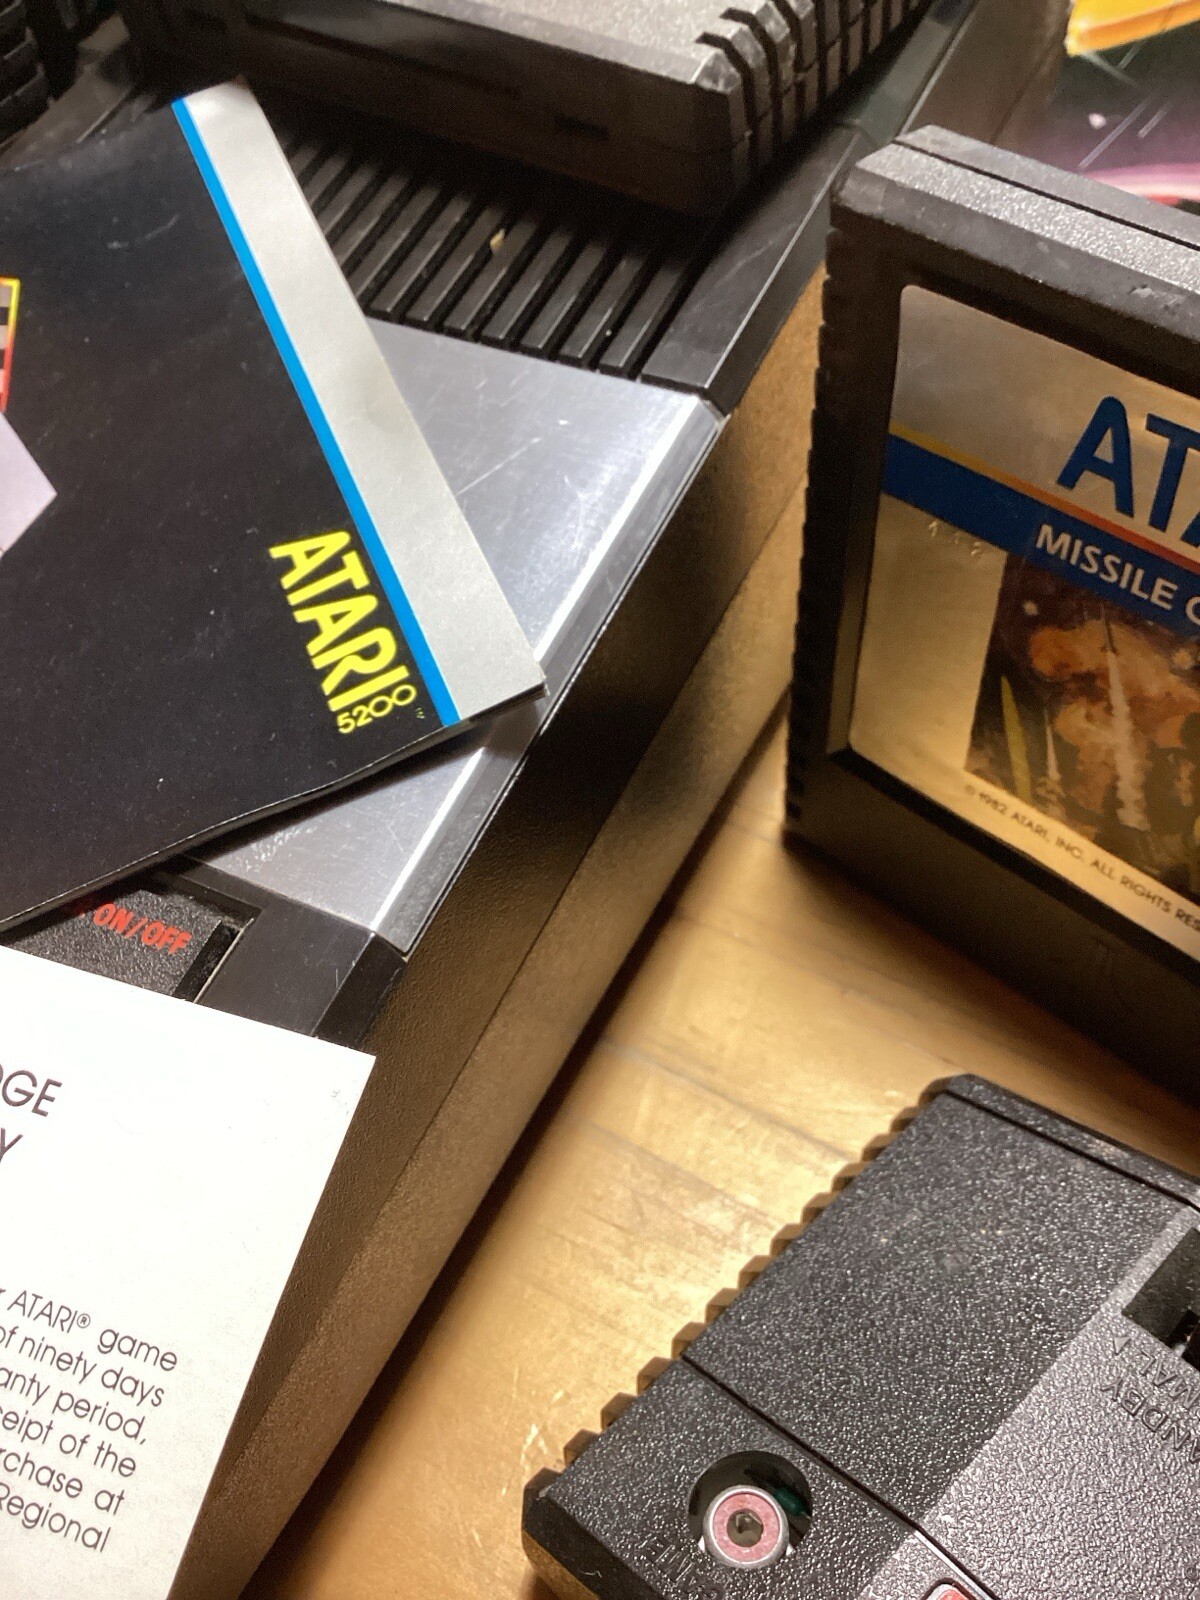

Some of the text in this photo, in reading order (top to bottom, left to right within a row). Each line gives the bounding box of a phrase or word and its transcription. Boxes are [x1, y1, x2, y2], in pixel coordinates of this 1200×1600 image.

[1056, 396, 1200, 548] AT
[1036, 525, 1179, 610] MISSILE
[269, 530, 410, 712] ATARI
[336, 684, 417, 734] 5200
[978, 792, 1007, 815] 1982
[1091, 859, 1115, 881] ALL
[1120, 874, 1171, 913] RIGHTS
[93, 903, 192, 955] ON/OFF
[0, 1064, 62, 1117] GE
[18, 1336, 97, 1384] ninety
[101, 1367, 165, 1407] days
[97, 1328, 178, 1372] game
[1139, 1350, 1200, 1421] MAL
[0, 1405, 137, 1478] eipt of the
[52, 1390, 146, 1445] period,
[94, 1489, 125, 1515] at
